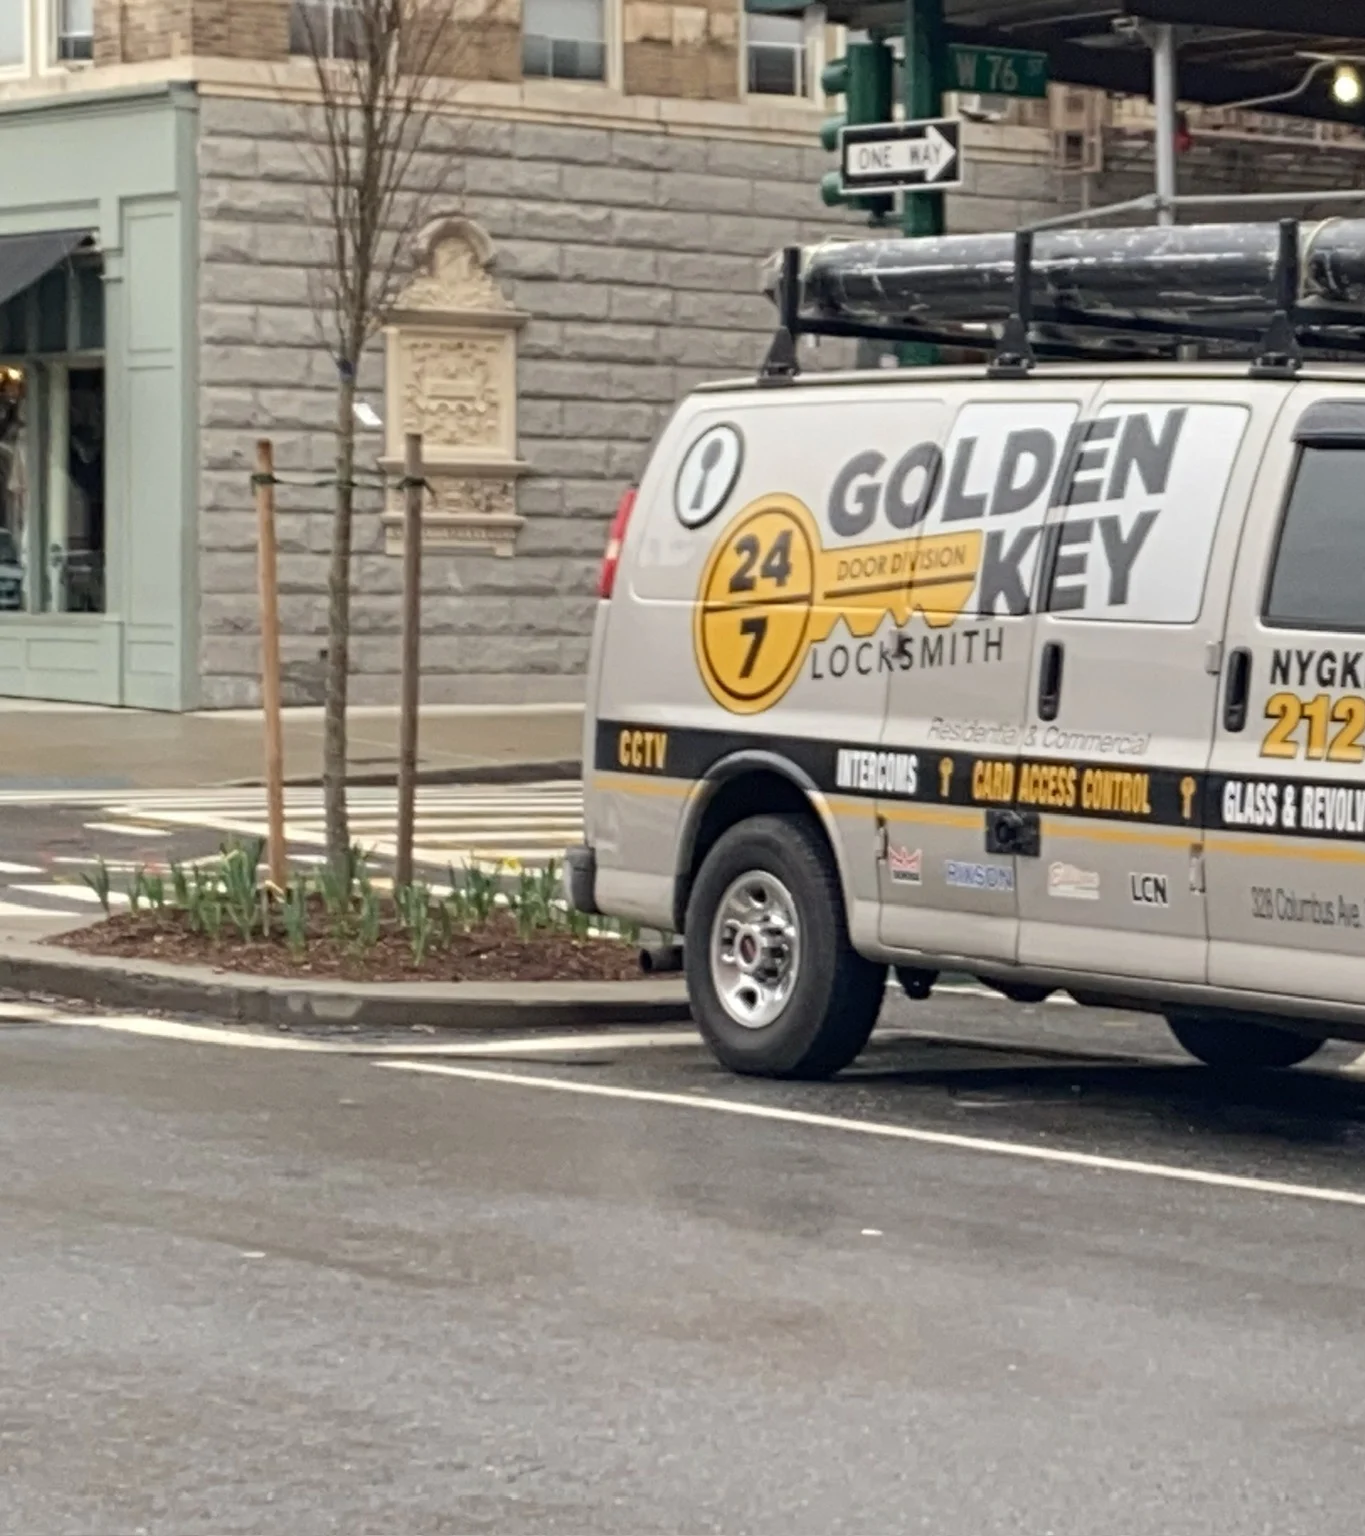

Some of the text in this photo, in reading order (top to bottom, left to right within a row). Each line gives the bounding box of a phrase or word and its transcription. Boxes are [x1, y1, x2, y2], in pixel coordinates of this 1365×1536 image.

[956, 54, 976, 87] W
[986, 55, 1018, 91] 76
[859, 143, 943, 170] ONE WAY
[828, 407, 1189, 538] GOLDEN
[727, 530, 794, 593] 24
[836, 544, 967, 582] DOOR DIVISION
[975, 510, 1162, 620] KEY
[739, 617, 769, 679] 7
[811, 627, 1005, 680] LOCKSMITH
[619, 730, 667, 769] CCTV
[927, 716, 1152, 756] Residential & Commercial
[836, 748, 918, 794] INTERCOMS
[972, 760, 1151, 813] CARD ACCESS CONTROL
[1222, 781, 1278, 827] GLASS
[1281, 785, 1296, 828] &
[1132, 874, 1168, 904] LCN
[1276, 888, 1334, 925] Columbus
